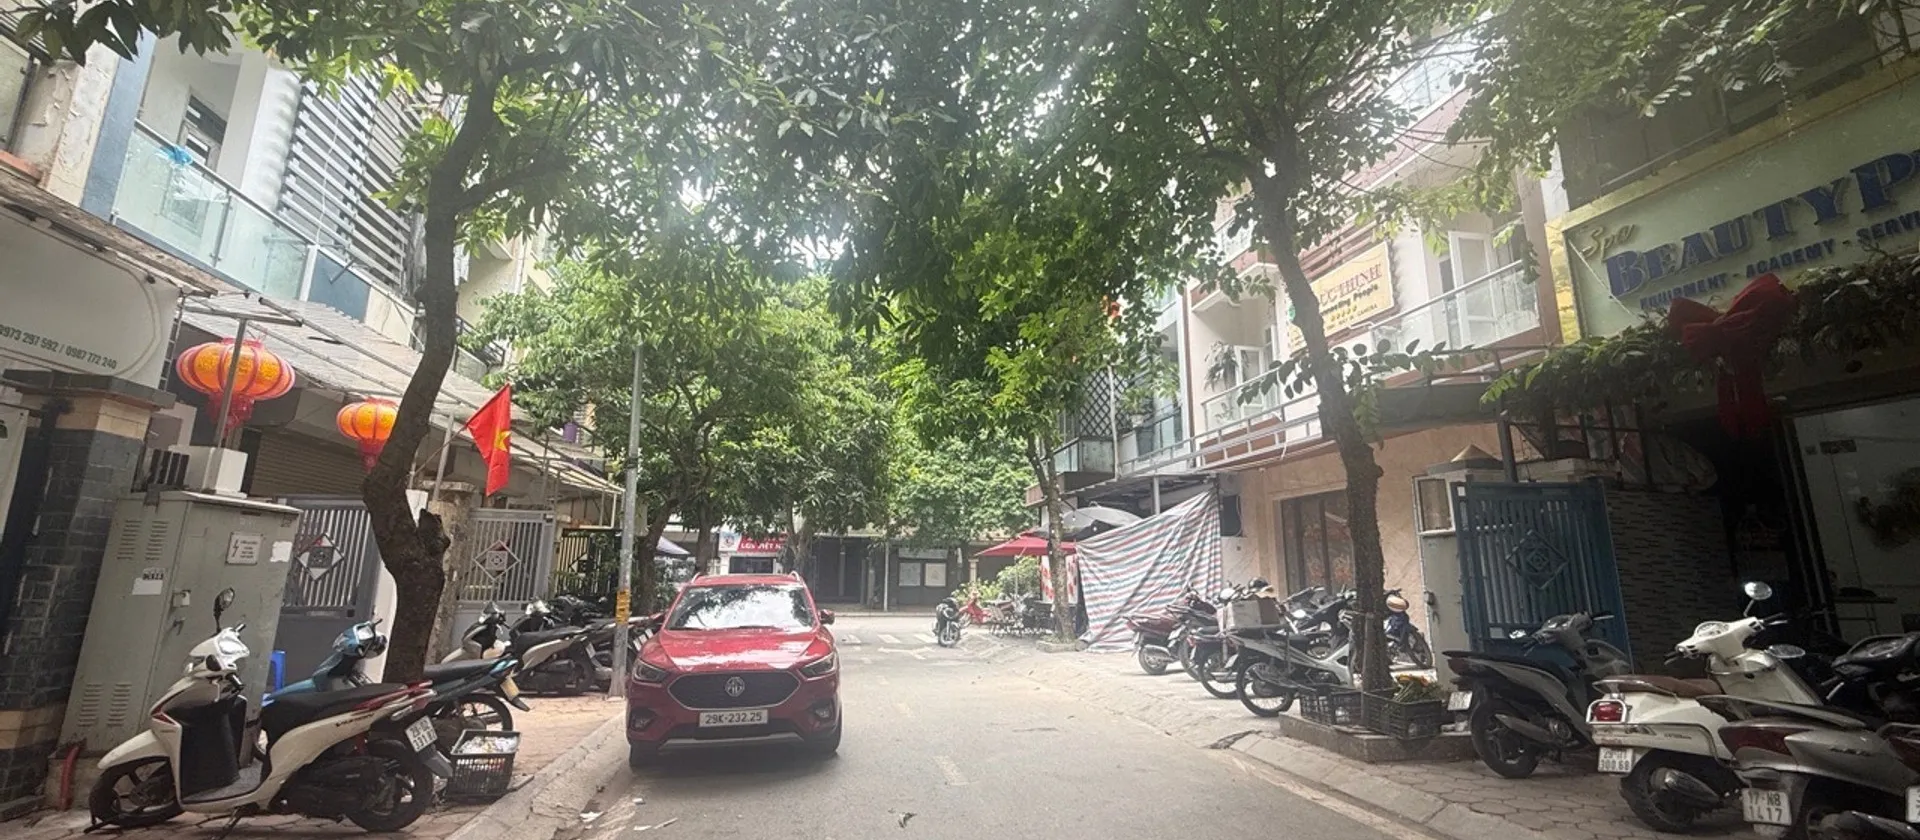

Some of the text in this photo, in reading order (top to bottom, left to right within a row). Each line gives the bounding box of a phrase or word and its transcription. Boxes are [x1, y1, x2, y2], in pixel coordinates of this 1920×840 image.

[1580, 224, 1637, 260] Spa
[1604, 149, 1920, 298] BEAUTYP
[1745, 238, 1837, 278] ACADEMY
